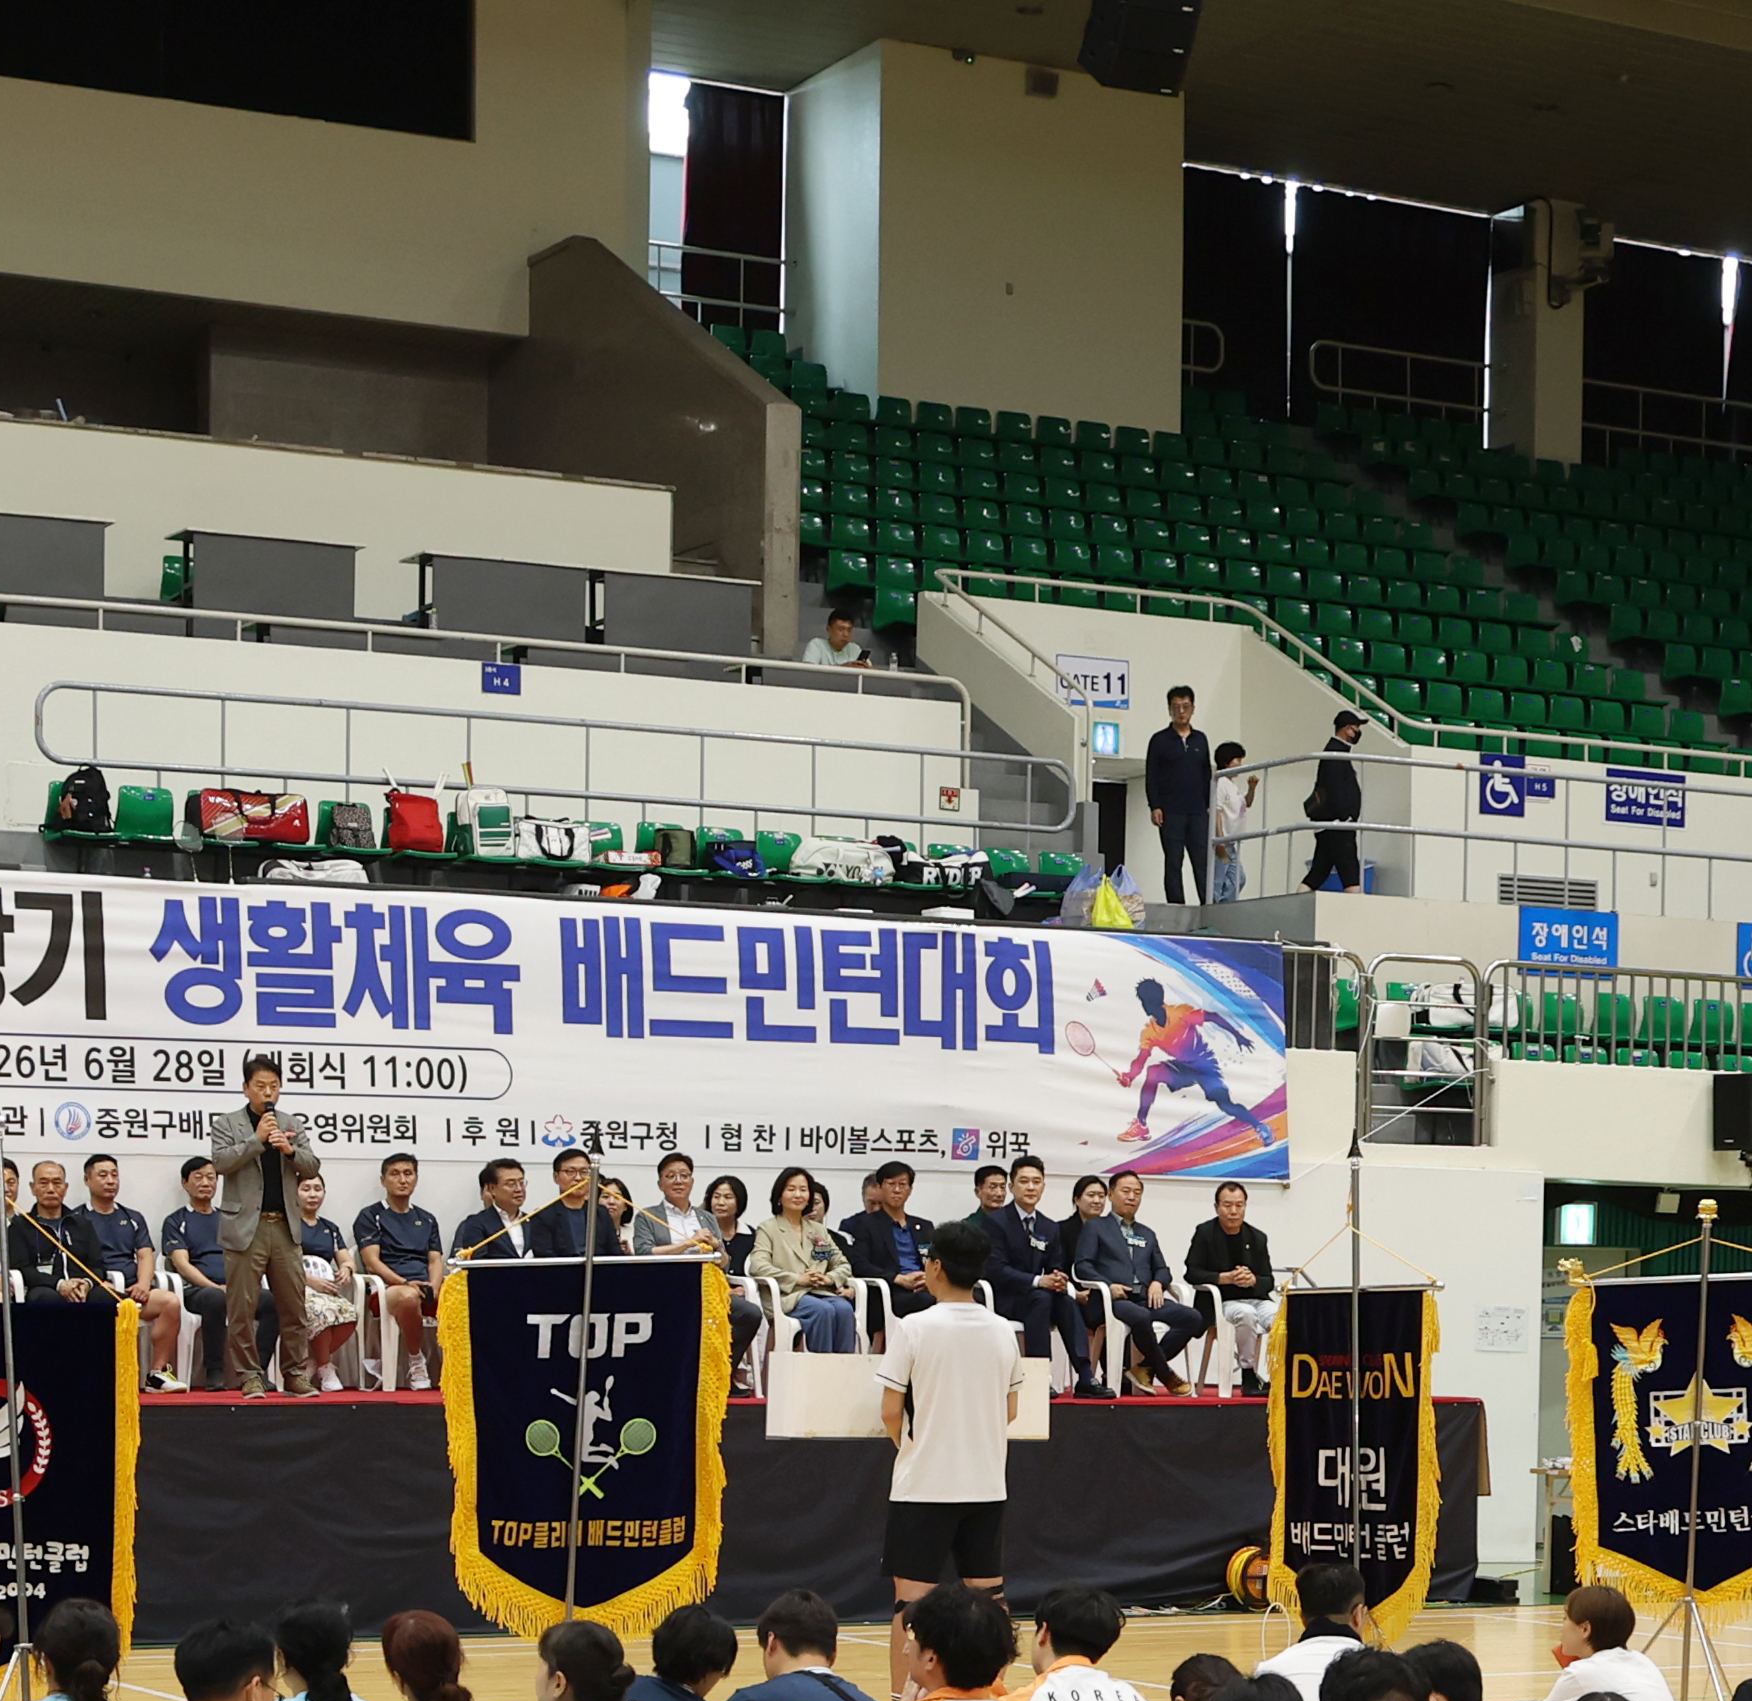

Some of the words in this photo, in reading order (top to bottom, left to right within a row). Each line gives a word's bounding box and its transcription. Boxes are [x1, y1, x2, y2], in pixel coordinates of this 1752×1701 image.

[1102, 672, 1126, 695] 11
[1610, 803, 1629, 815] Seat
[1631, 805, 1645, 817] For
[1532, 922, 1609, 951] 장애인석
[1531, 952, 1552, 962] Seat
[1554, 953, 1568, 963] For
[148, 895, 521, 1035] 생활체육
[559, 915, 1055, 1055] 배드민턴대회
[83, 1045, 136, 1084] 6월
[152, 1047, 226, 1087] 28일
[243, 1048, 347, 1090] (회식
[362, 1054, 468, 1094] 11:00)
[526, 1312, 655, 1359] TOP
[1700, 1421, 1731, 1440] CLUB
[1317, 1446, 1387, 1512] 대원
[587, 1514, 687, 1548] 배드민턴클럽
